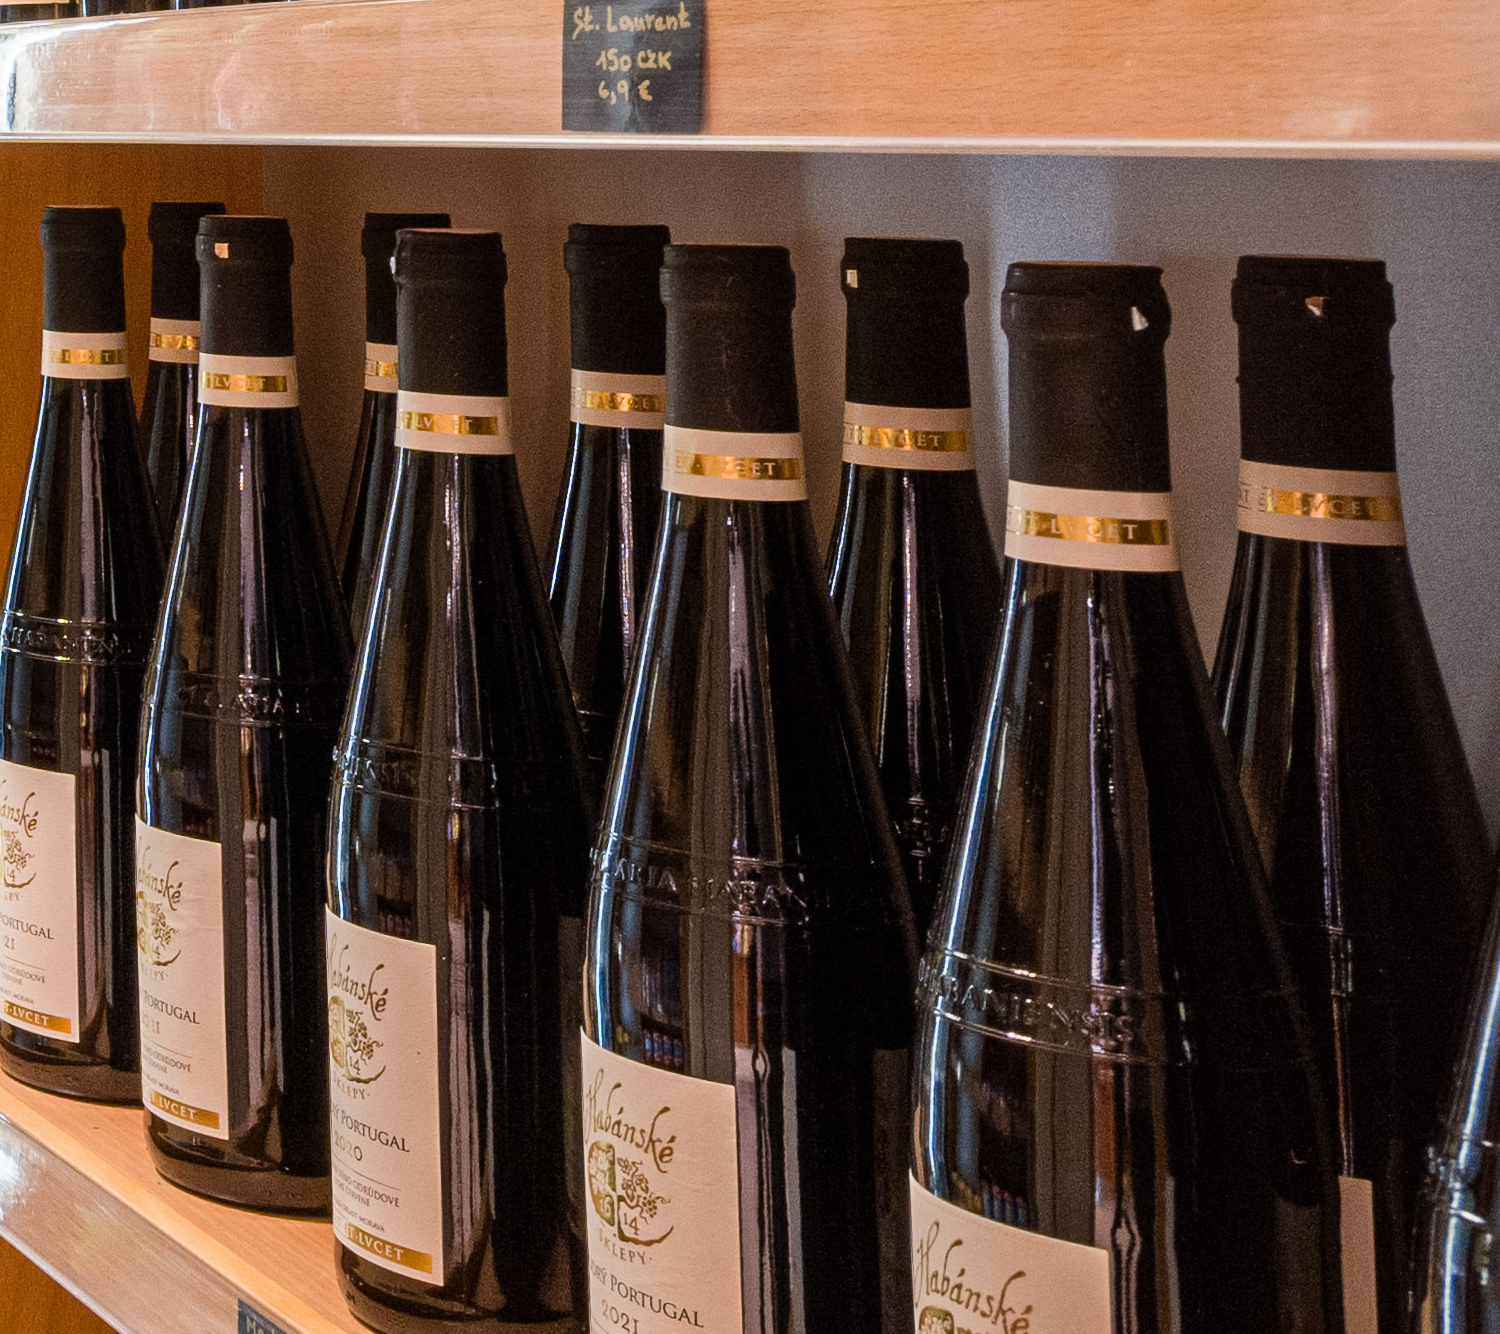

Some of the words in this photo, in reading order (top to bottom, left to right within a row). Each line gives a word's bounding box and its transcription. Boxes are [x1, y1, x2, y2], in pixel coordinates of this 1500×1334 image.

[607, 0, 691, 32] Laurent
[596, 48, 631, 71] 150
[637, 49, 673, 70] CZK
[598, 80, 630, 105] 6,9
[585, 1068, 677, 1174] Habánské
[598, 1228, 650, 1265] SKLEPY
[610, 1273, 705, 1330] PORTUGAL
